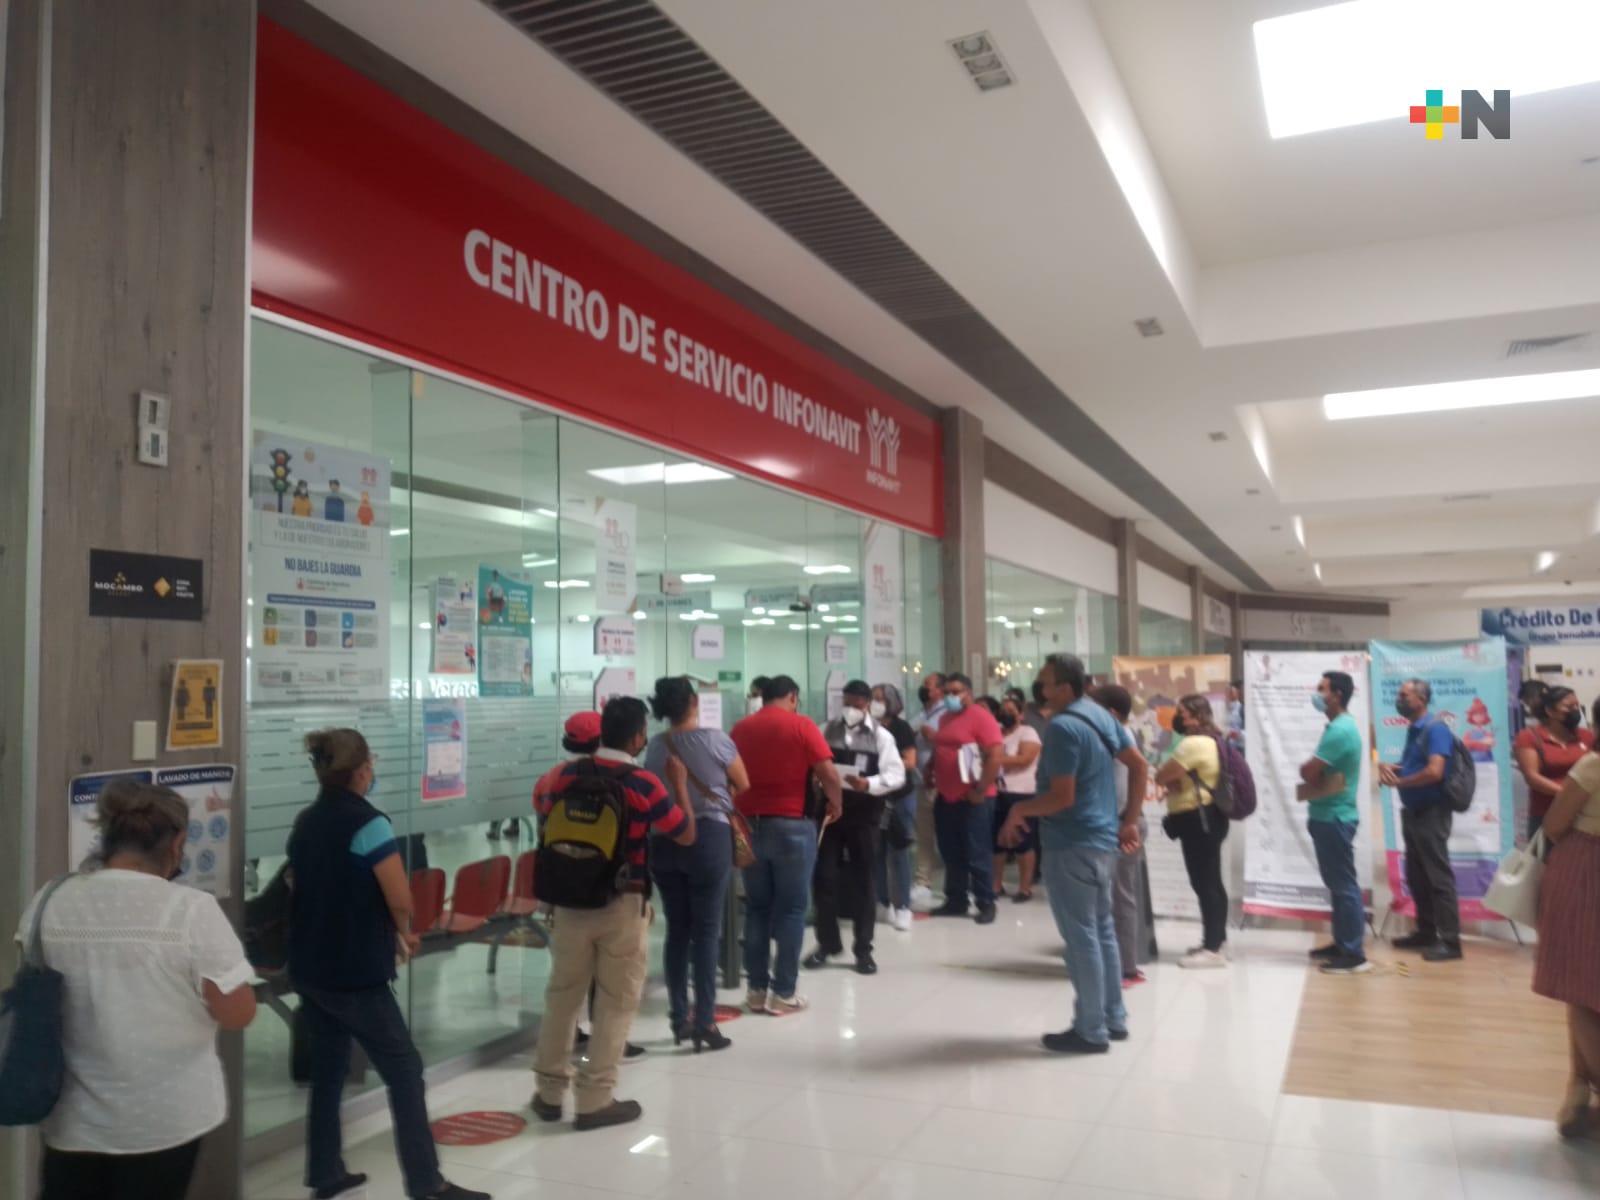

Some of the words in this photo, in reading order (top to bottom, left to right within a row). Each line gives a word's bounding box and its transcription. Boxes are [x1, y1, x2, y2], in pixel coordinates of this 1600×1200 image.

[464, 229, 609, 341] CENTRO
[618, 303, 657, 364] DE
[664, 328, 768, 413] SERVICIO
[773, 382, 861, 454] INFONAVIT
[285, 557, 296, 570] NO
[297, 558, 319, 573] BAJES
[320, 560, 329, 574] LA
[330, 563, 362, 577] GUARDIA
[94, 581, 143, 592] MOCAMBO
[1499, 608, 1565, 628] Crédito
[1569, 608, 1593, 626] De
[159, 773, 189, 783] LAVADO
[190, 772, 199, 780] DE
